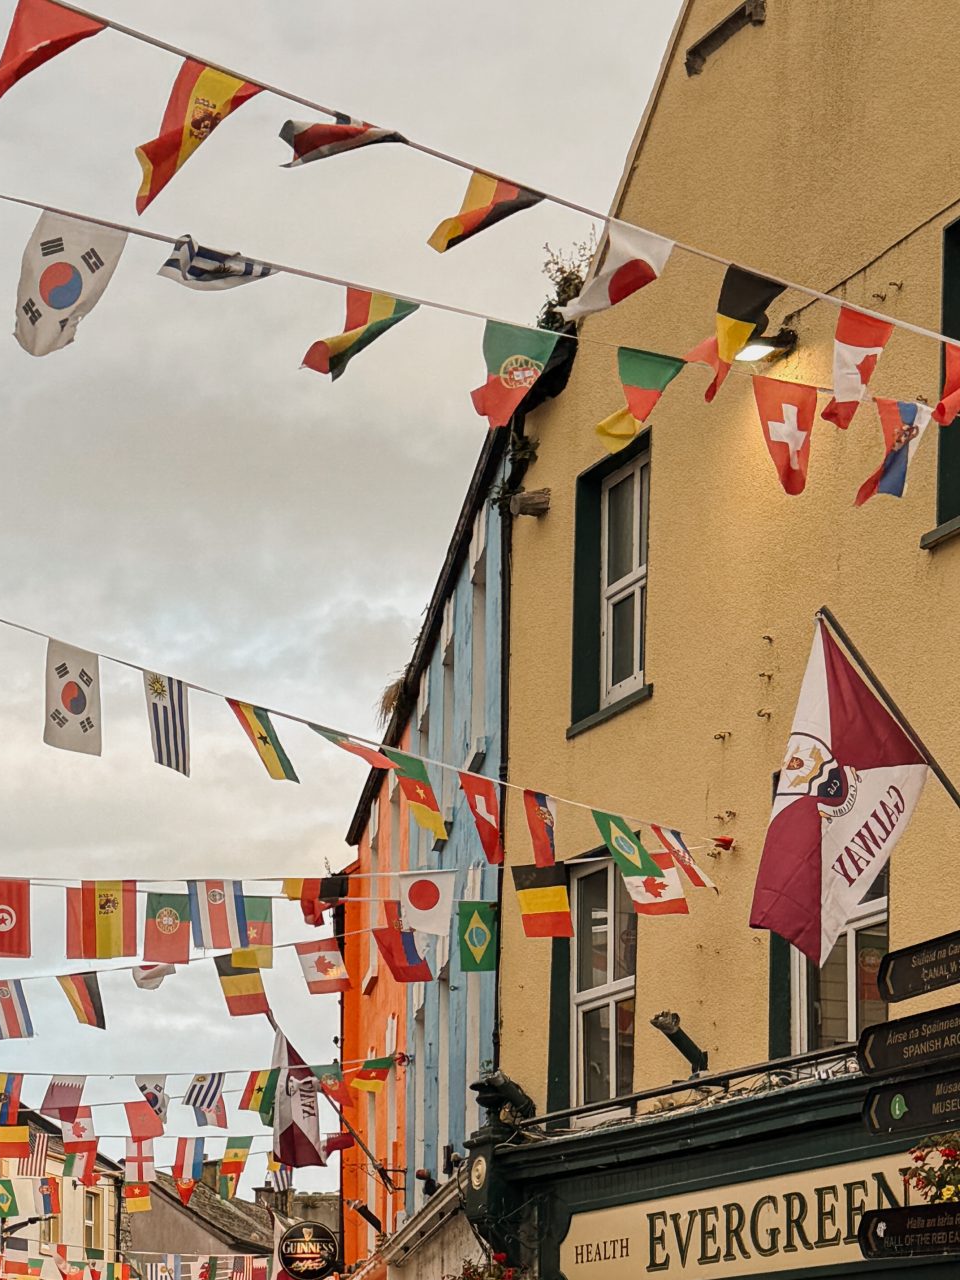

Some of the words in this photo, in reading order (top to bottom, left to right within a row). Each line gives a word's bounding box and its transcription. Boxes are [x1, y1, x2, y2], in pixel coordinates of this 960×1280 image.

[903, 1039, 941, 1059] SPANISH
[282, 1241, 335, 1254] GUINNESS
[574, 1237, 631, 1265] HEALTH
